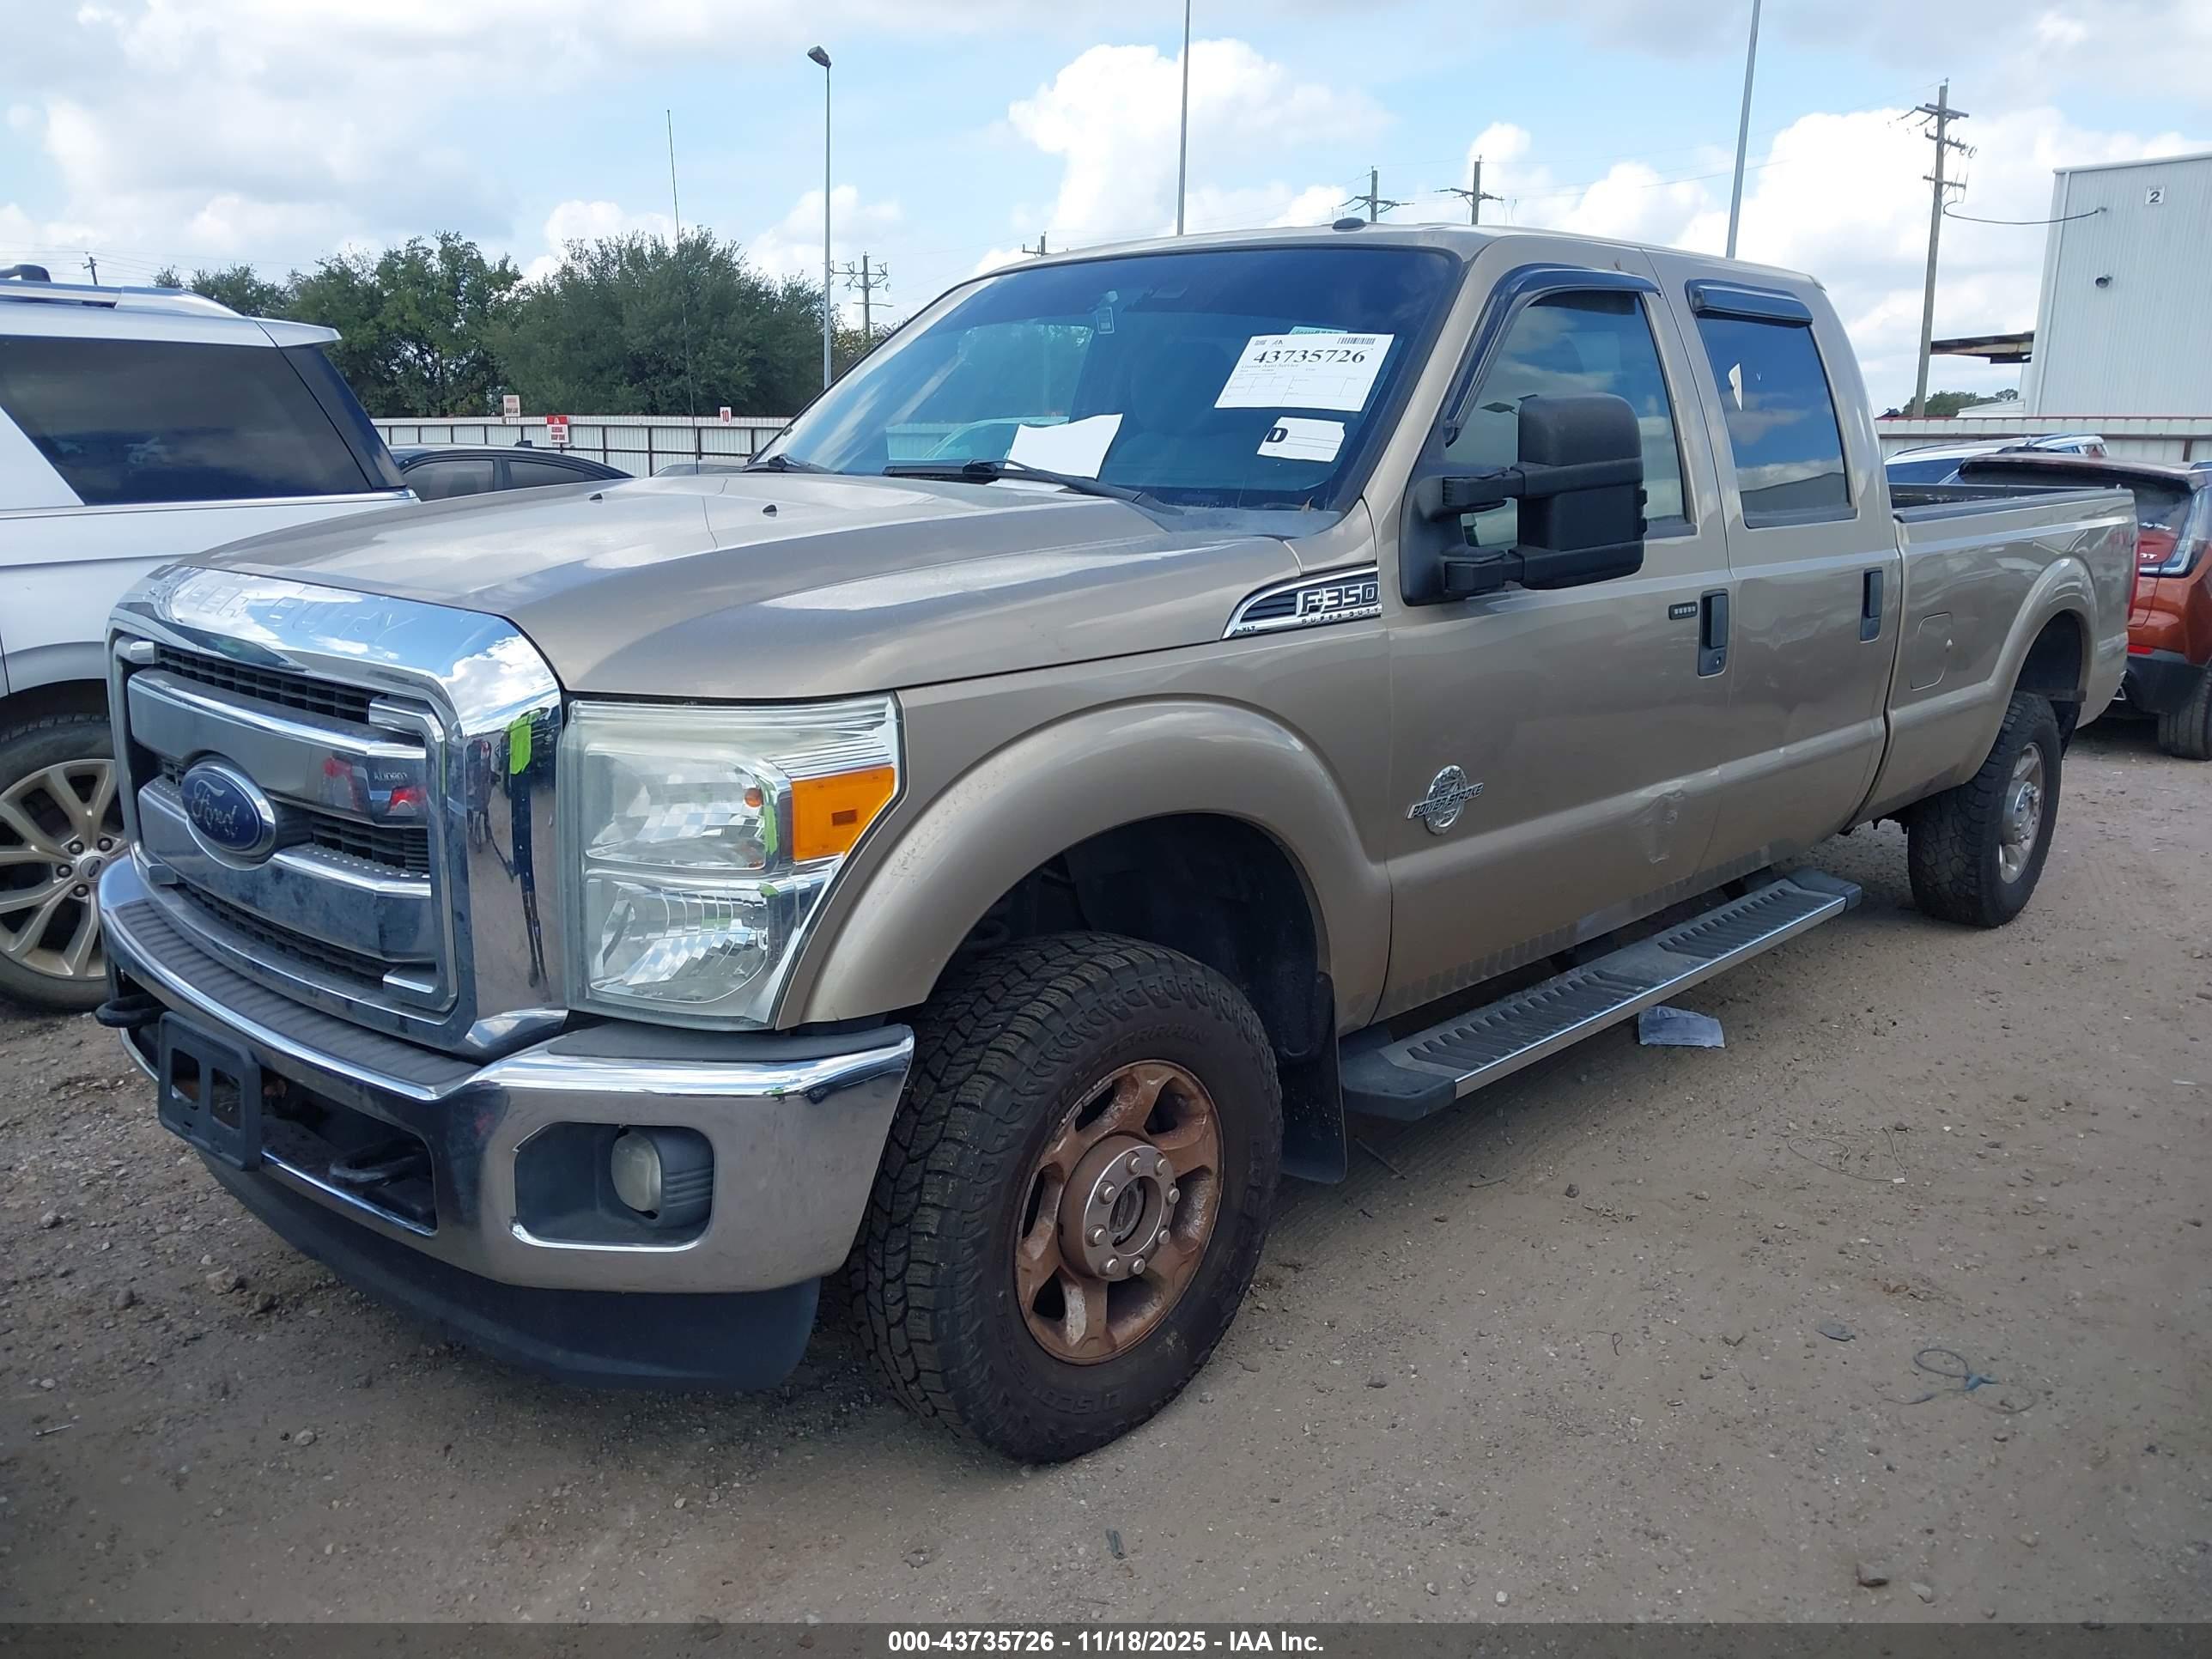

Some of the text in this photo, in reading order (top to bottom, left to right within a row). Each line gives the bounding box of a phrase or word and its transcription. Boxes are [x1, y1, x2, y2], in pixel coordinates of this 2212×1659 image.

[2149, 191, 2160, 204] 2
[1253, 349, 1367, 364] 43735726
[1265, 427, 1289, 443] D
[191, 779, 238, 839] Ford
